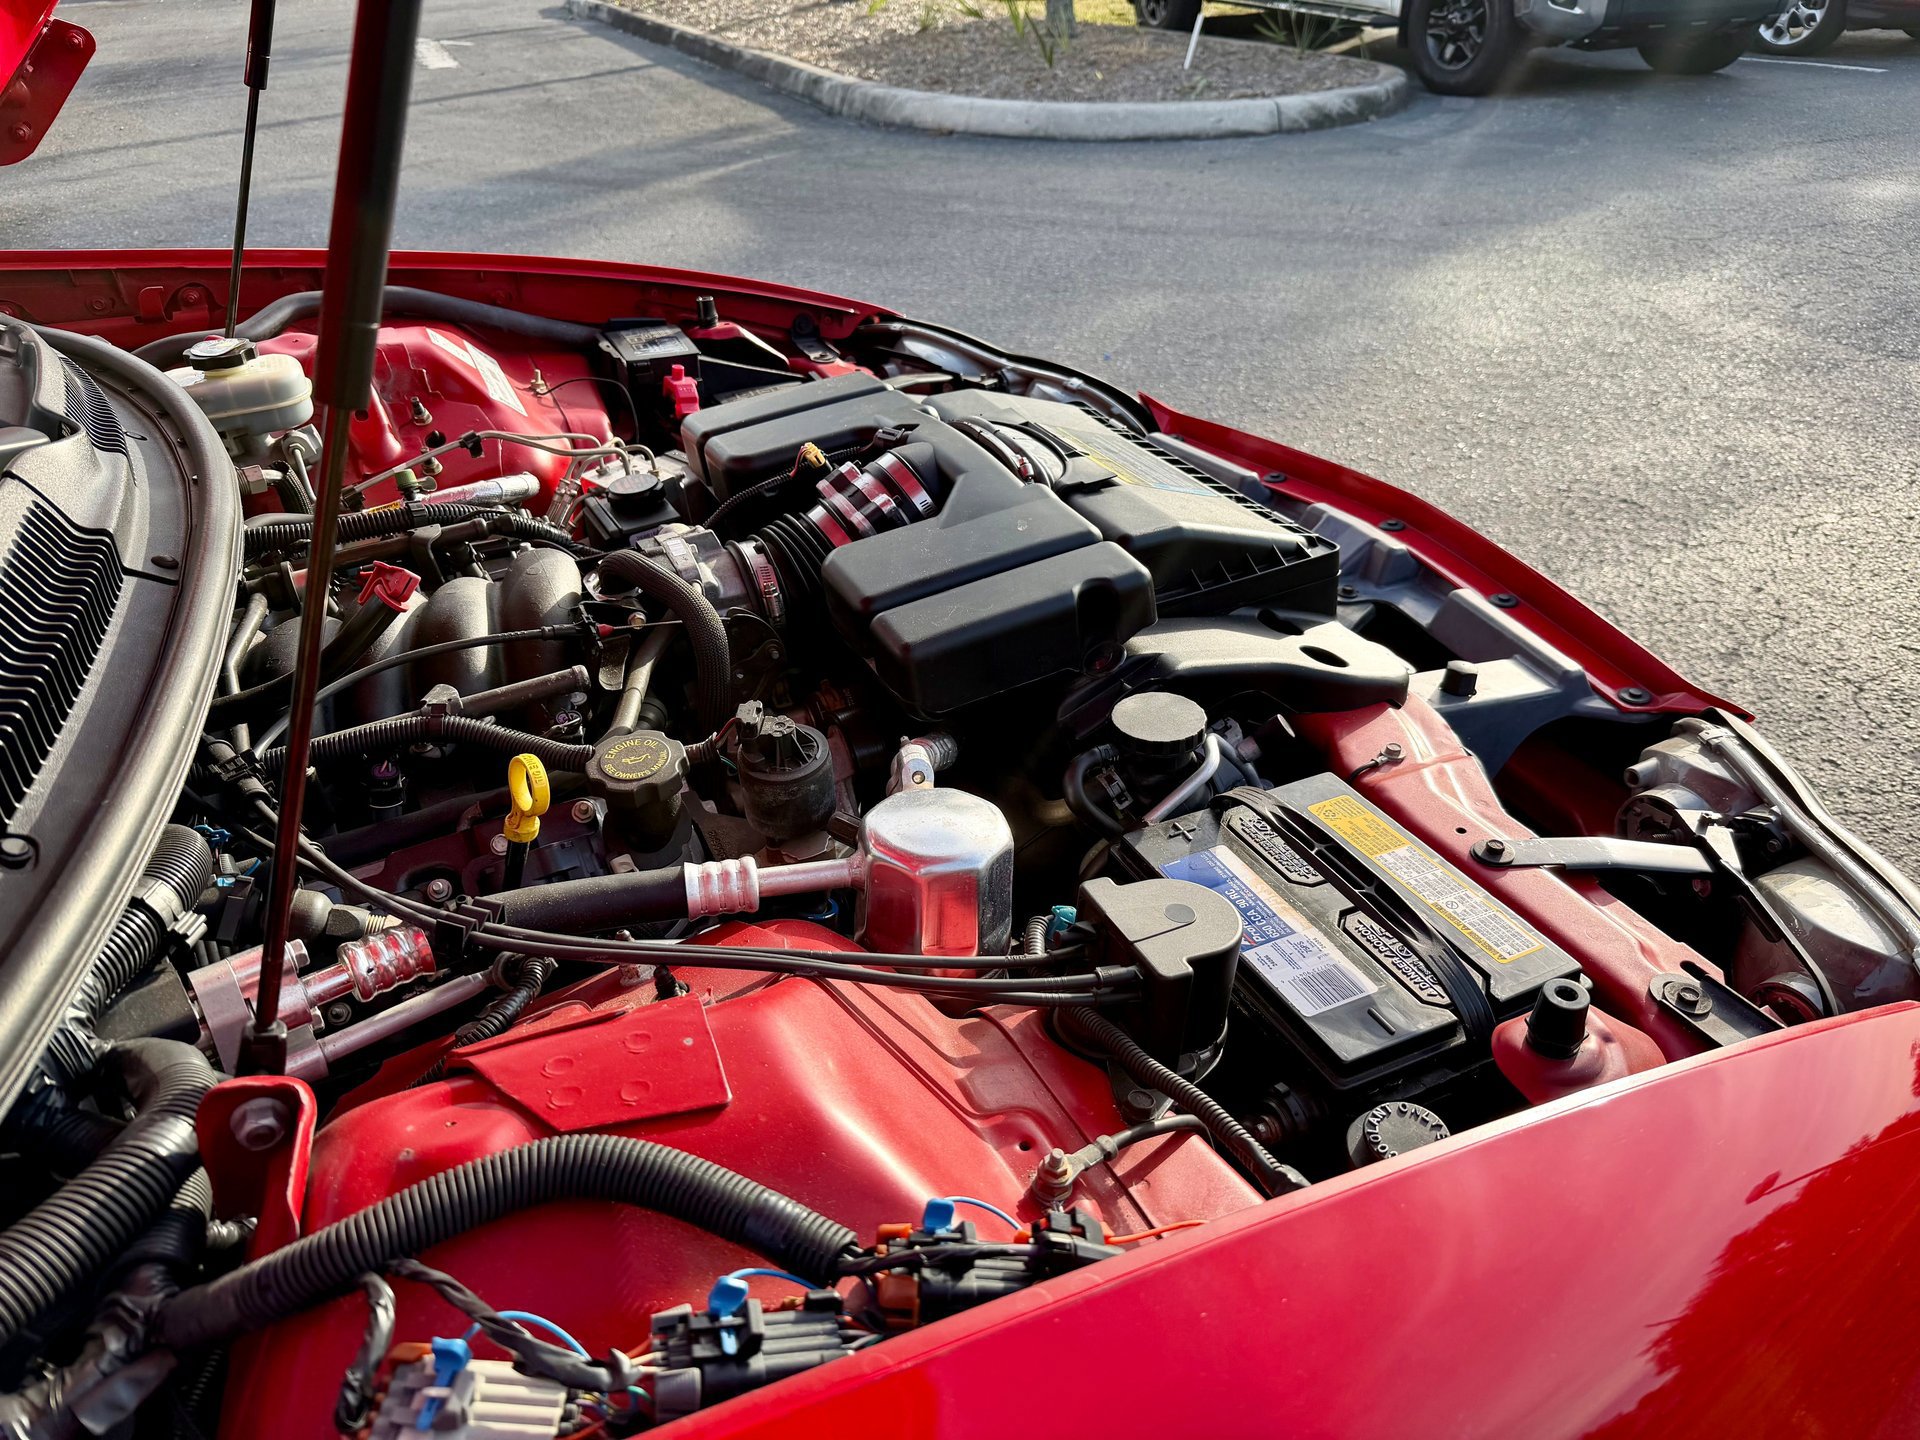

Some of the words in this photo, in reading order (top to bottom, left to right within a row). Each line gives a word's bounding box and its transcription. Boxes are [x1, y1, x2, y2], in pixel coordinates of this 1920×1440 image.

[605, 739, 641, 759] ENGINE
[643, 739, 659, 749] OIL
[604, 763, 617, 774] SEE
[614, 770, 651, 779] OWNER'S
[650, 749, 668, 772] MANUAL
[1225, 889, 1241, 900] RC
[1236, 898, 1249, 909] 90
[1247, 909, 1266, 926] CCA
[1261, 925, 1280, 938] 650
[1367, 1103, 1398, 1158] COOLANT
[1397, 1102, 1443, 1127] ONLY
